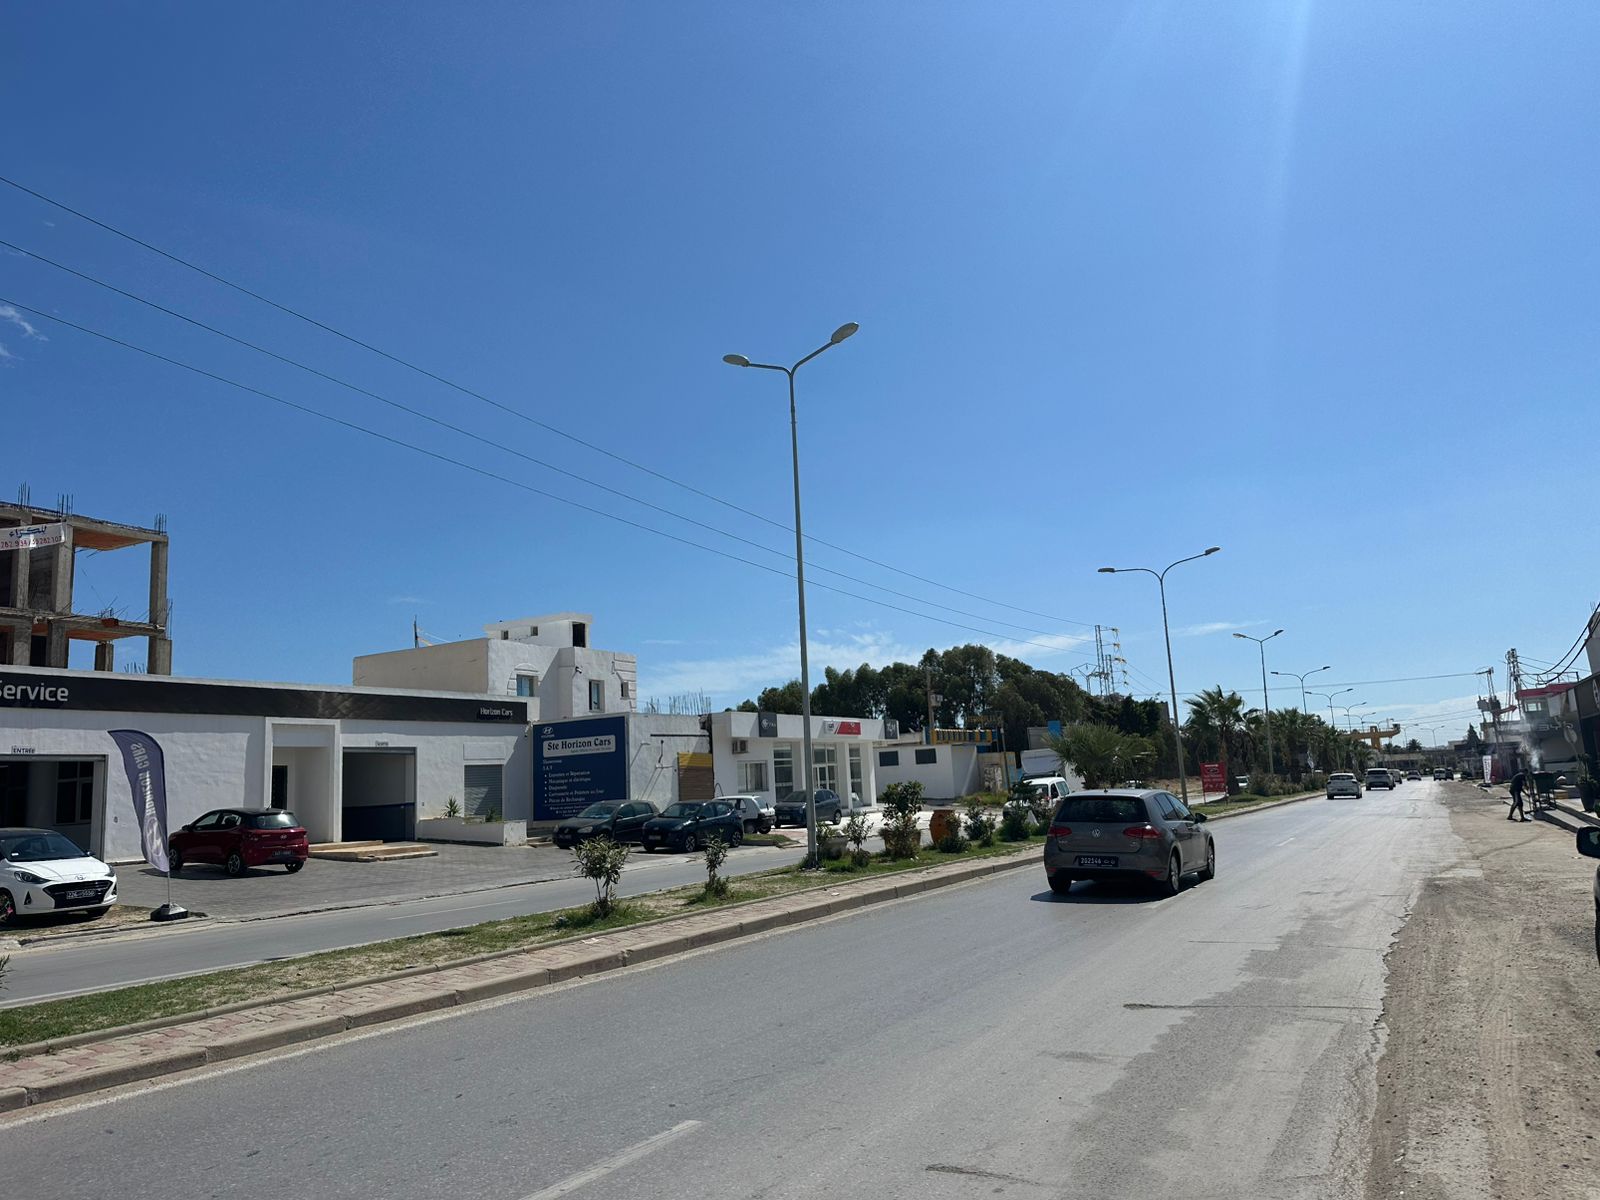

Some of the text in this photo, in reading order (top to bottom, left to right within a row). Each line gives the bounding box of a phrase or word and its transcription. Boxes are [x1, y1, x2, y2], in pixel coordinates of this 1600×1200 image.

[0, 681, 69, 701] ervice
[480, 707, 513, 716] Horizon Cars
[547, 742, 559, 751] Ste
[561, 740, 592, 750] Horizon
[594, 738, 612, 748] Cars
